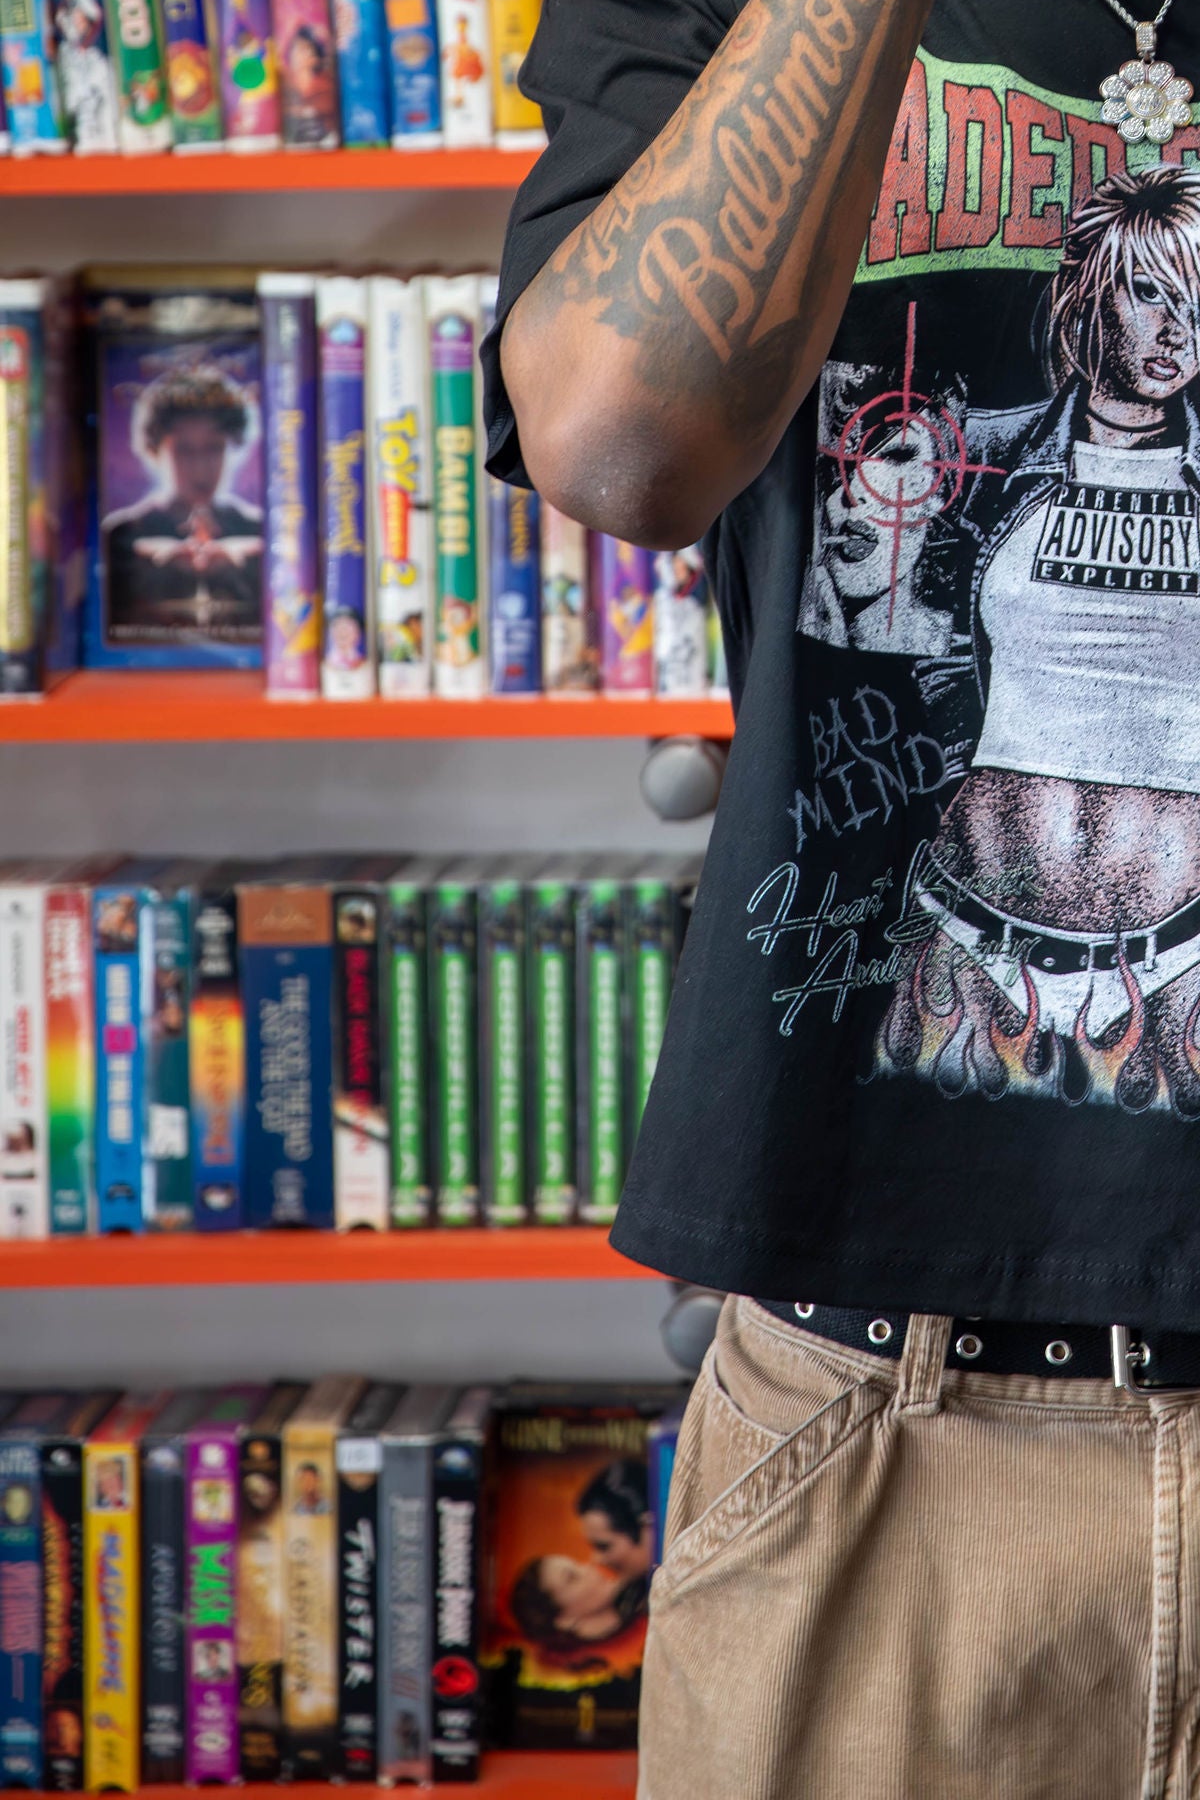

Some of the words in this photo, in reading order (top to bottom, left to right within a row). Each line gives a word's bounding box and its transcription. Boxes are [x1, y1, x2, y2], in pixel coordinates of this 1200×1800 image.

[380, 411, 418, 491] TOY
[437, 425, 473, 557] BAMBI
[1043, 508, 1192, 569] ADVISORY
[1057, 483, 1193, 516] PARENTAL
[380, 560, 418, 588] 2
[1040, 562, 1192, 591] EXPLICIT
[808, 685, 899, 777] BAD
[786, 732, 950, 854] MIND
[438, 1498, 475, 1587] JURASSIC
[189, 1542, 233, 1628] MASK
[343, 1518, 374, 1689] TWISTER
[440, 1587, 474, 1646] PARK
